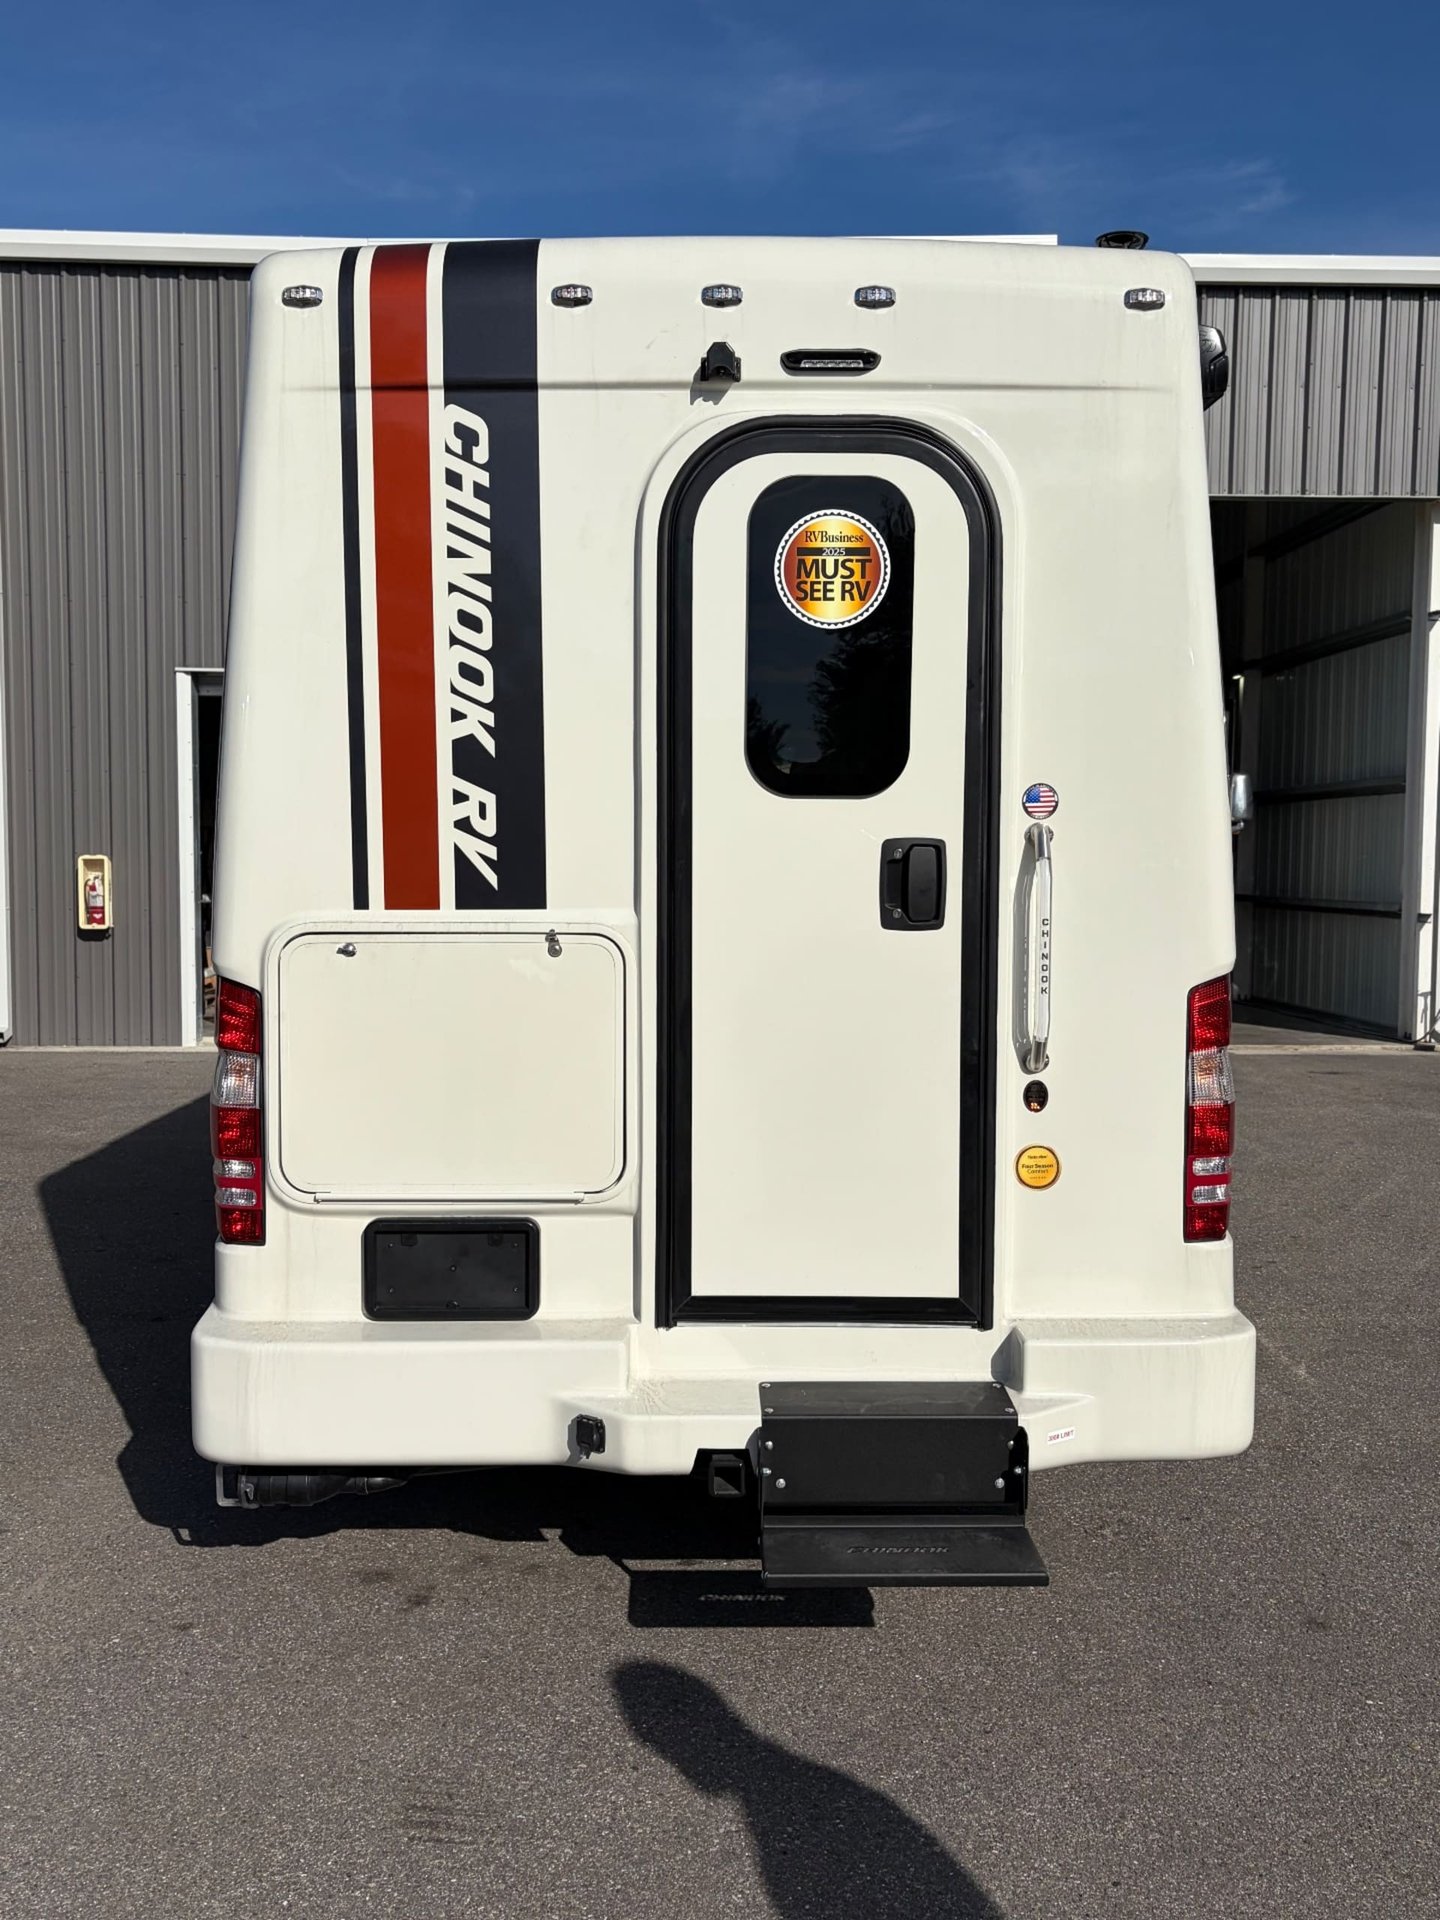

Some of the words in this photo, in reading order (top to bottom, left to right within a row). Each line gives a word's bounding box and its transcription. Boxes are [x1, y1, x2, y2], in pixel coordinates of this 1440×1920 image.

[804, 530, 864, 543] RVBusiness
[822, 547, 846, 556] 2025
[796, 558, 873, 580] MUST
[444, 403, 496, 759] CHINOOK
[795, 580, 835, 602] SEE
[840, 580, 872, 602] RV
[452, 774, 499, 891] RV
[1040, 918, 1049, 995] CHINOOK
